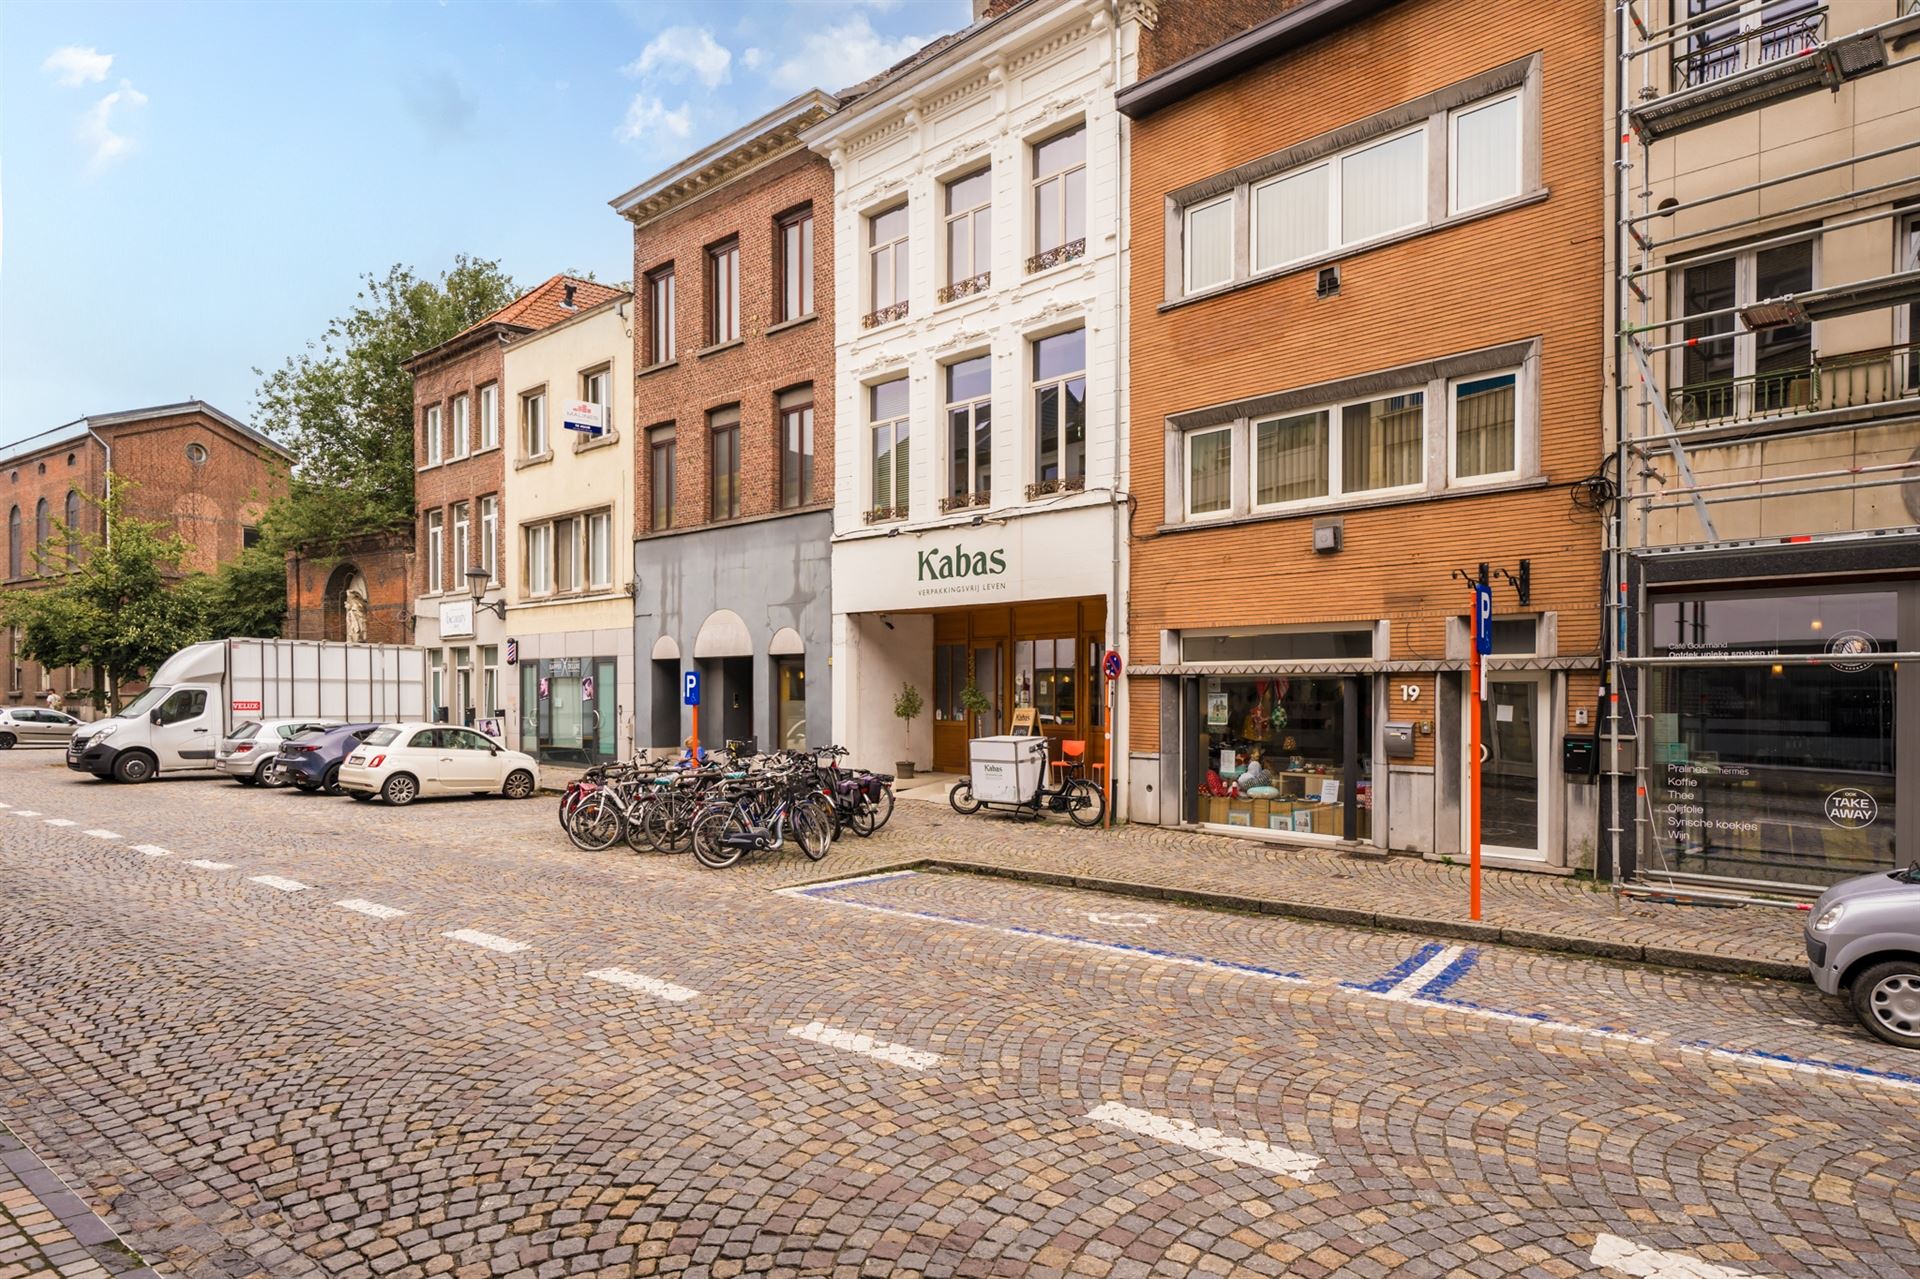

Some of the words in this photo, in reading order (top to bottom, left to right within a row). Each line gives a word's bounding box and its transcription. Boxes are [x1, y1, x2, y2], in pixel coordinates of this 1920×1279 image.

[918, 543, 1007, 581] Kabas
[918, 584, 980, 597] VERPAKKINGSVRIJ
[982, 582, 1007, 591] LEVEN
[1481, 592, 1490, 638] P
[1668, 642, 1686, 650] Café
[686, 674, 697, 698] P
[1400, 684, 1420, 701] 19
[984, 763, 1003, 773] Kabas
[1668, 763, 1708, 774] Pralines
[1668, 777, 1698, 787] Koffie
[1668, 790, 1695, 800] Thee
[1668, 803, 1704, 815] Olijfolie
[1832, 797, 1870, 809] TAKE
[1830, 808, 1872, 820] AWAY
[1668, 816, 1713, 828] Syrische
[1715, 820, 1758, 832] koekjes
[1668, 830, 1690, 841] Wijn
